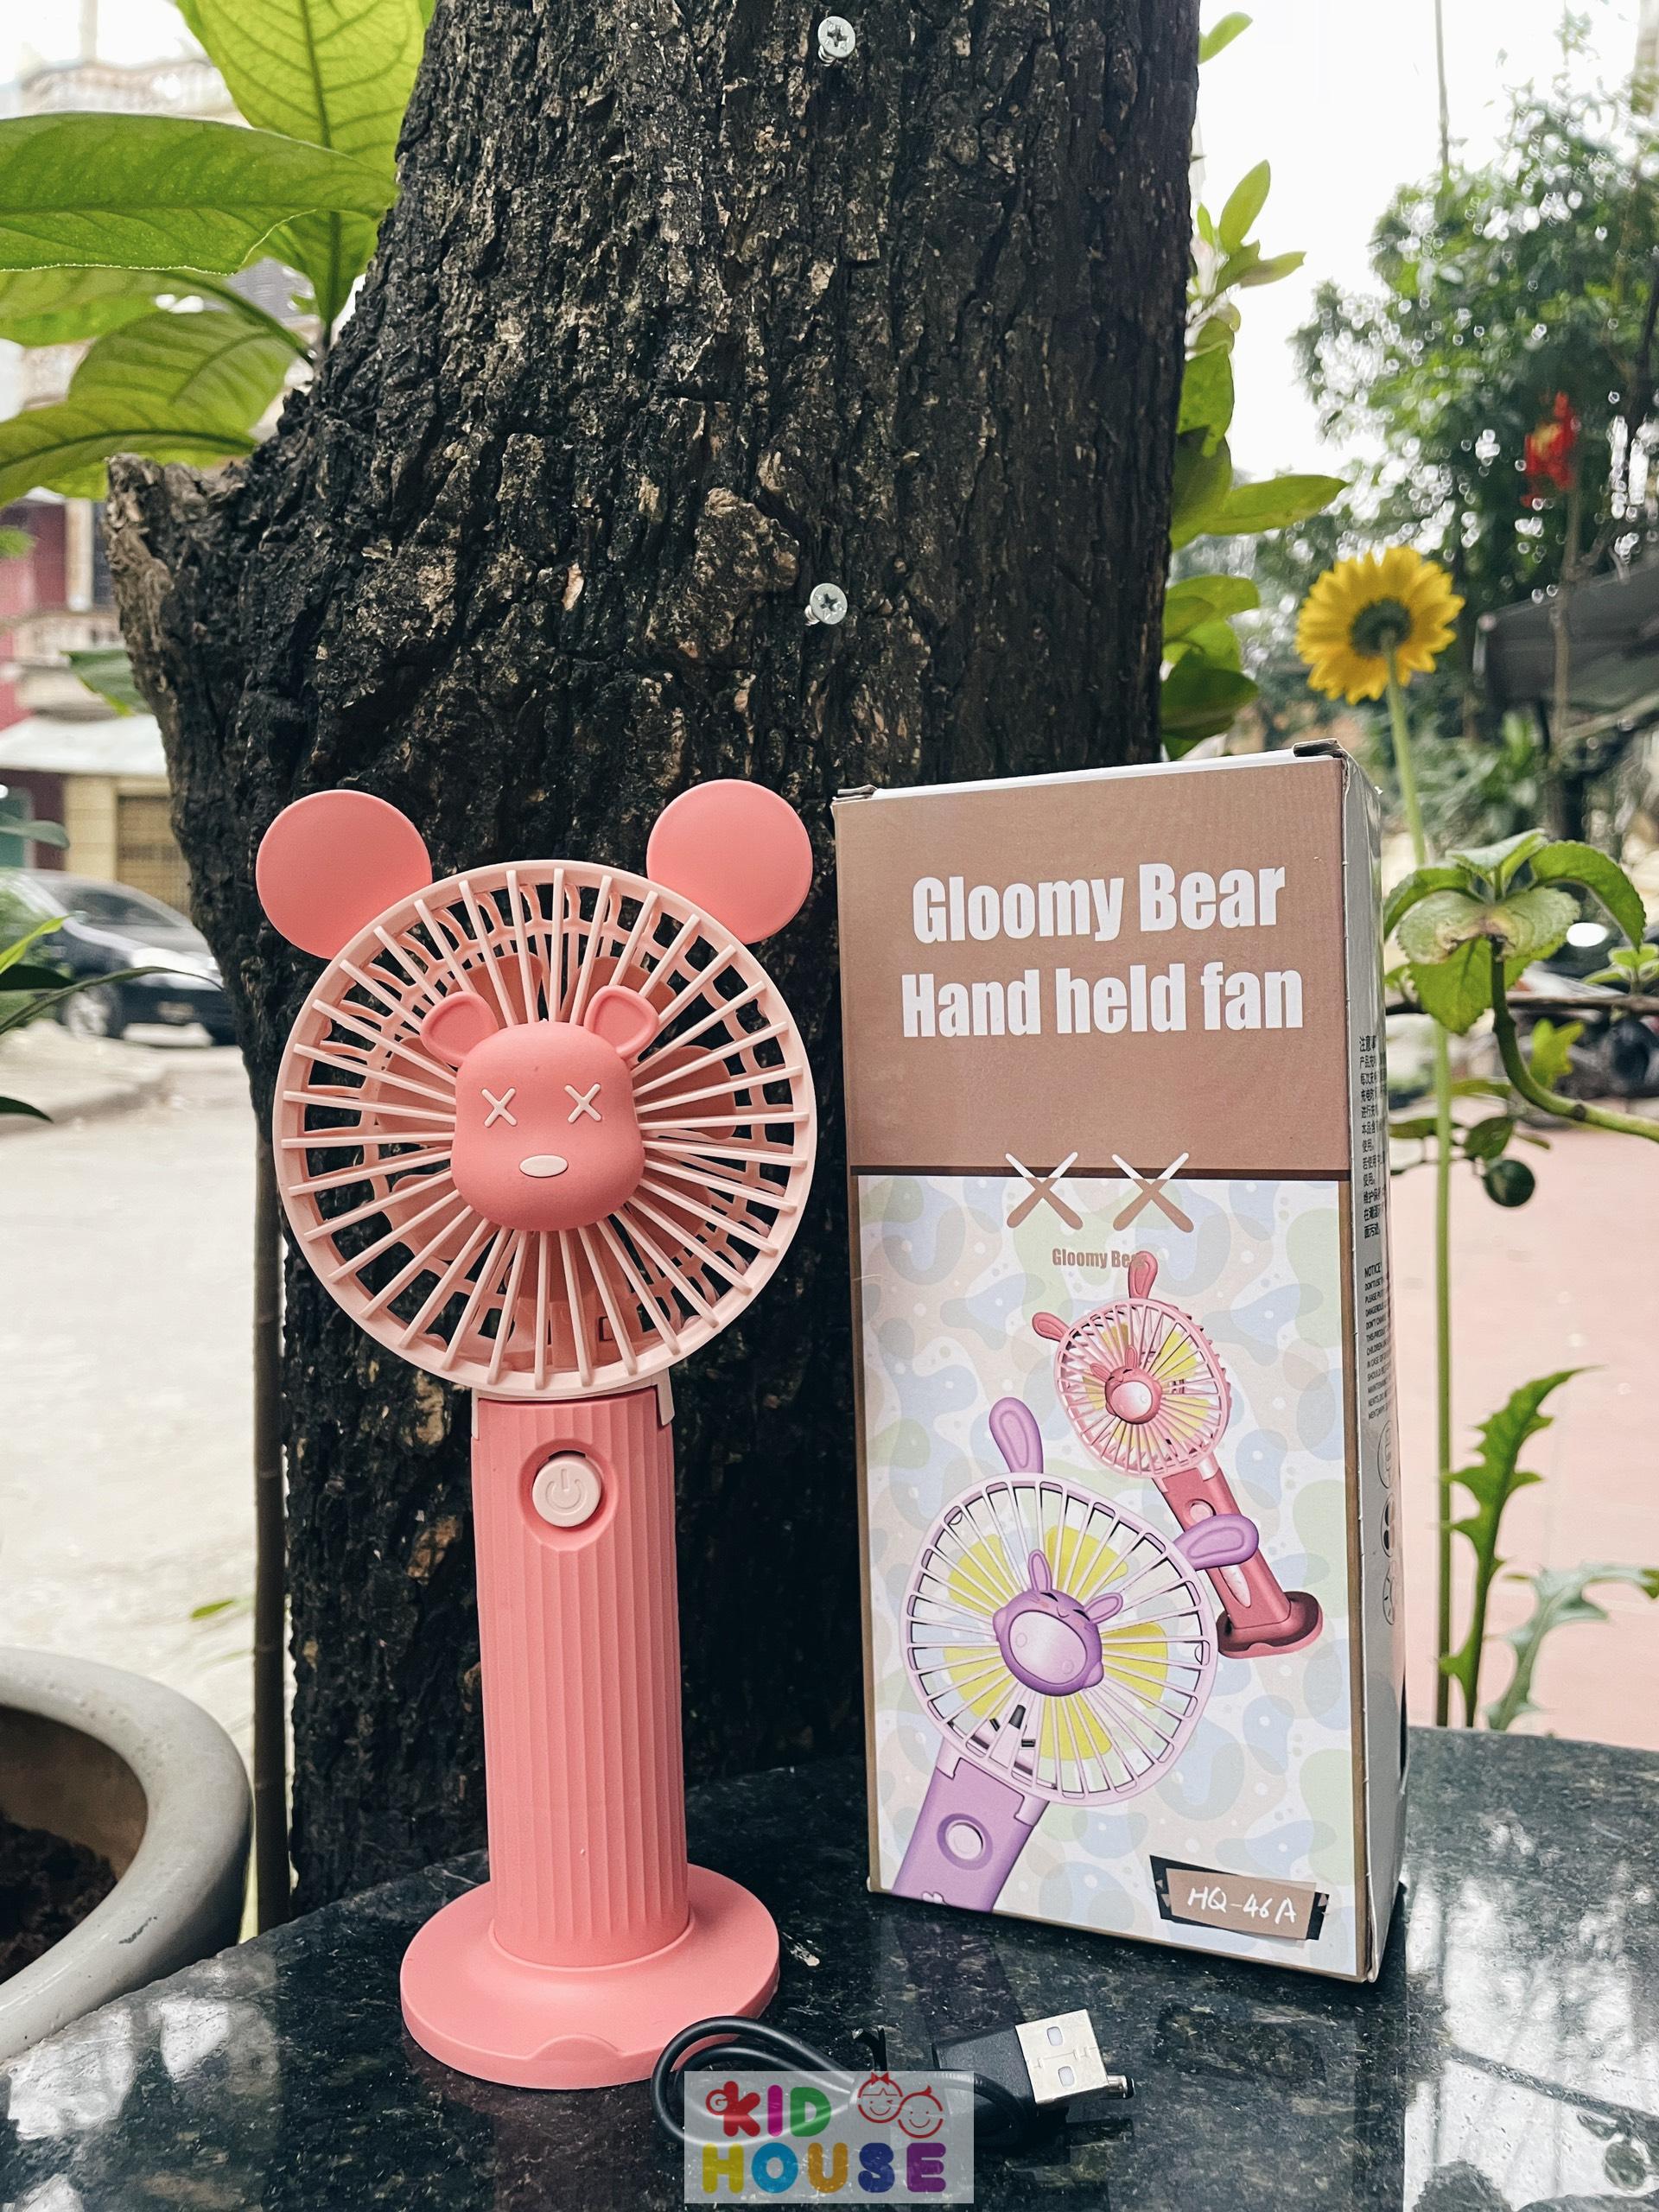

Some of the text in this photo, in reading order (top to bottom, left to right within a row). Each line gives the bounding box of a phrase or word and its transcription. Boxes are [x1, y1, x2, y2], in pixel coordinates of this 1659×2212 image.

[912, 863, 1286, 944] Gloomy Bear
[901, 962, 1304, 1038] Hand held fan
[1052, 1248, 1108, 1269] Gloomy
[1186, 1885, 1297, 1924] HQ-46A
